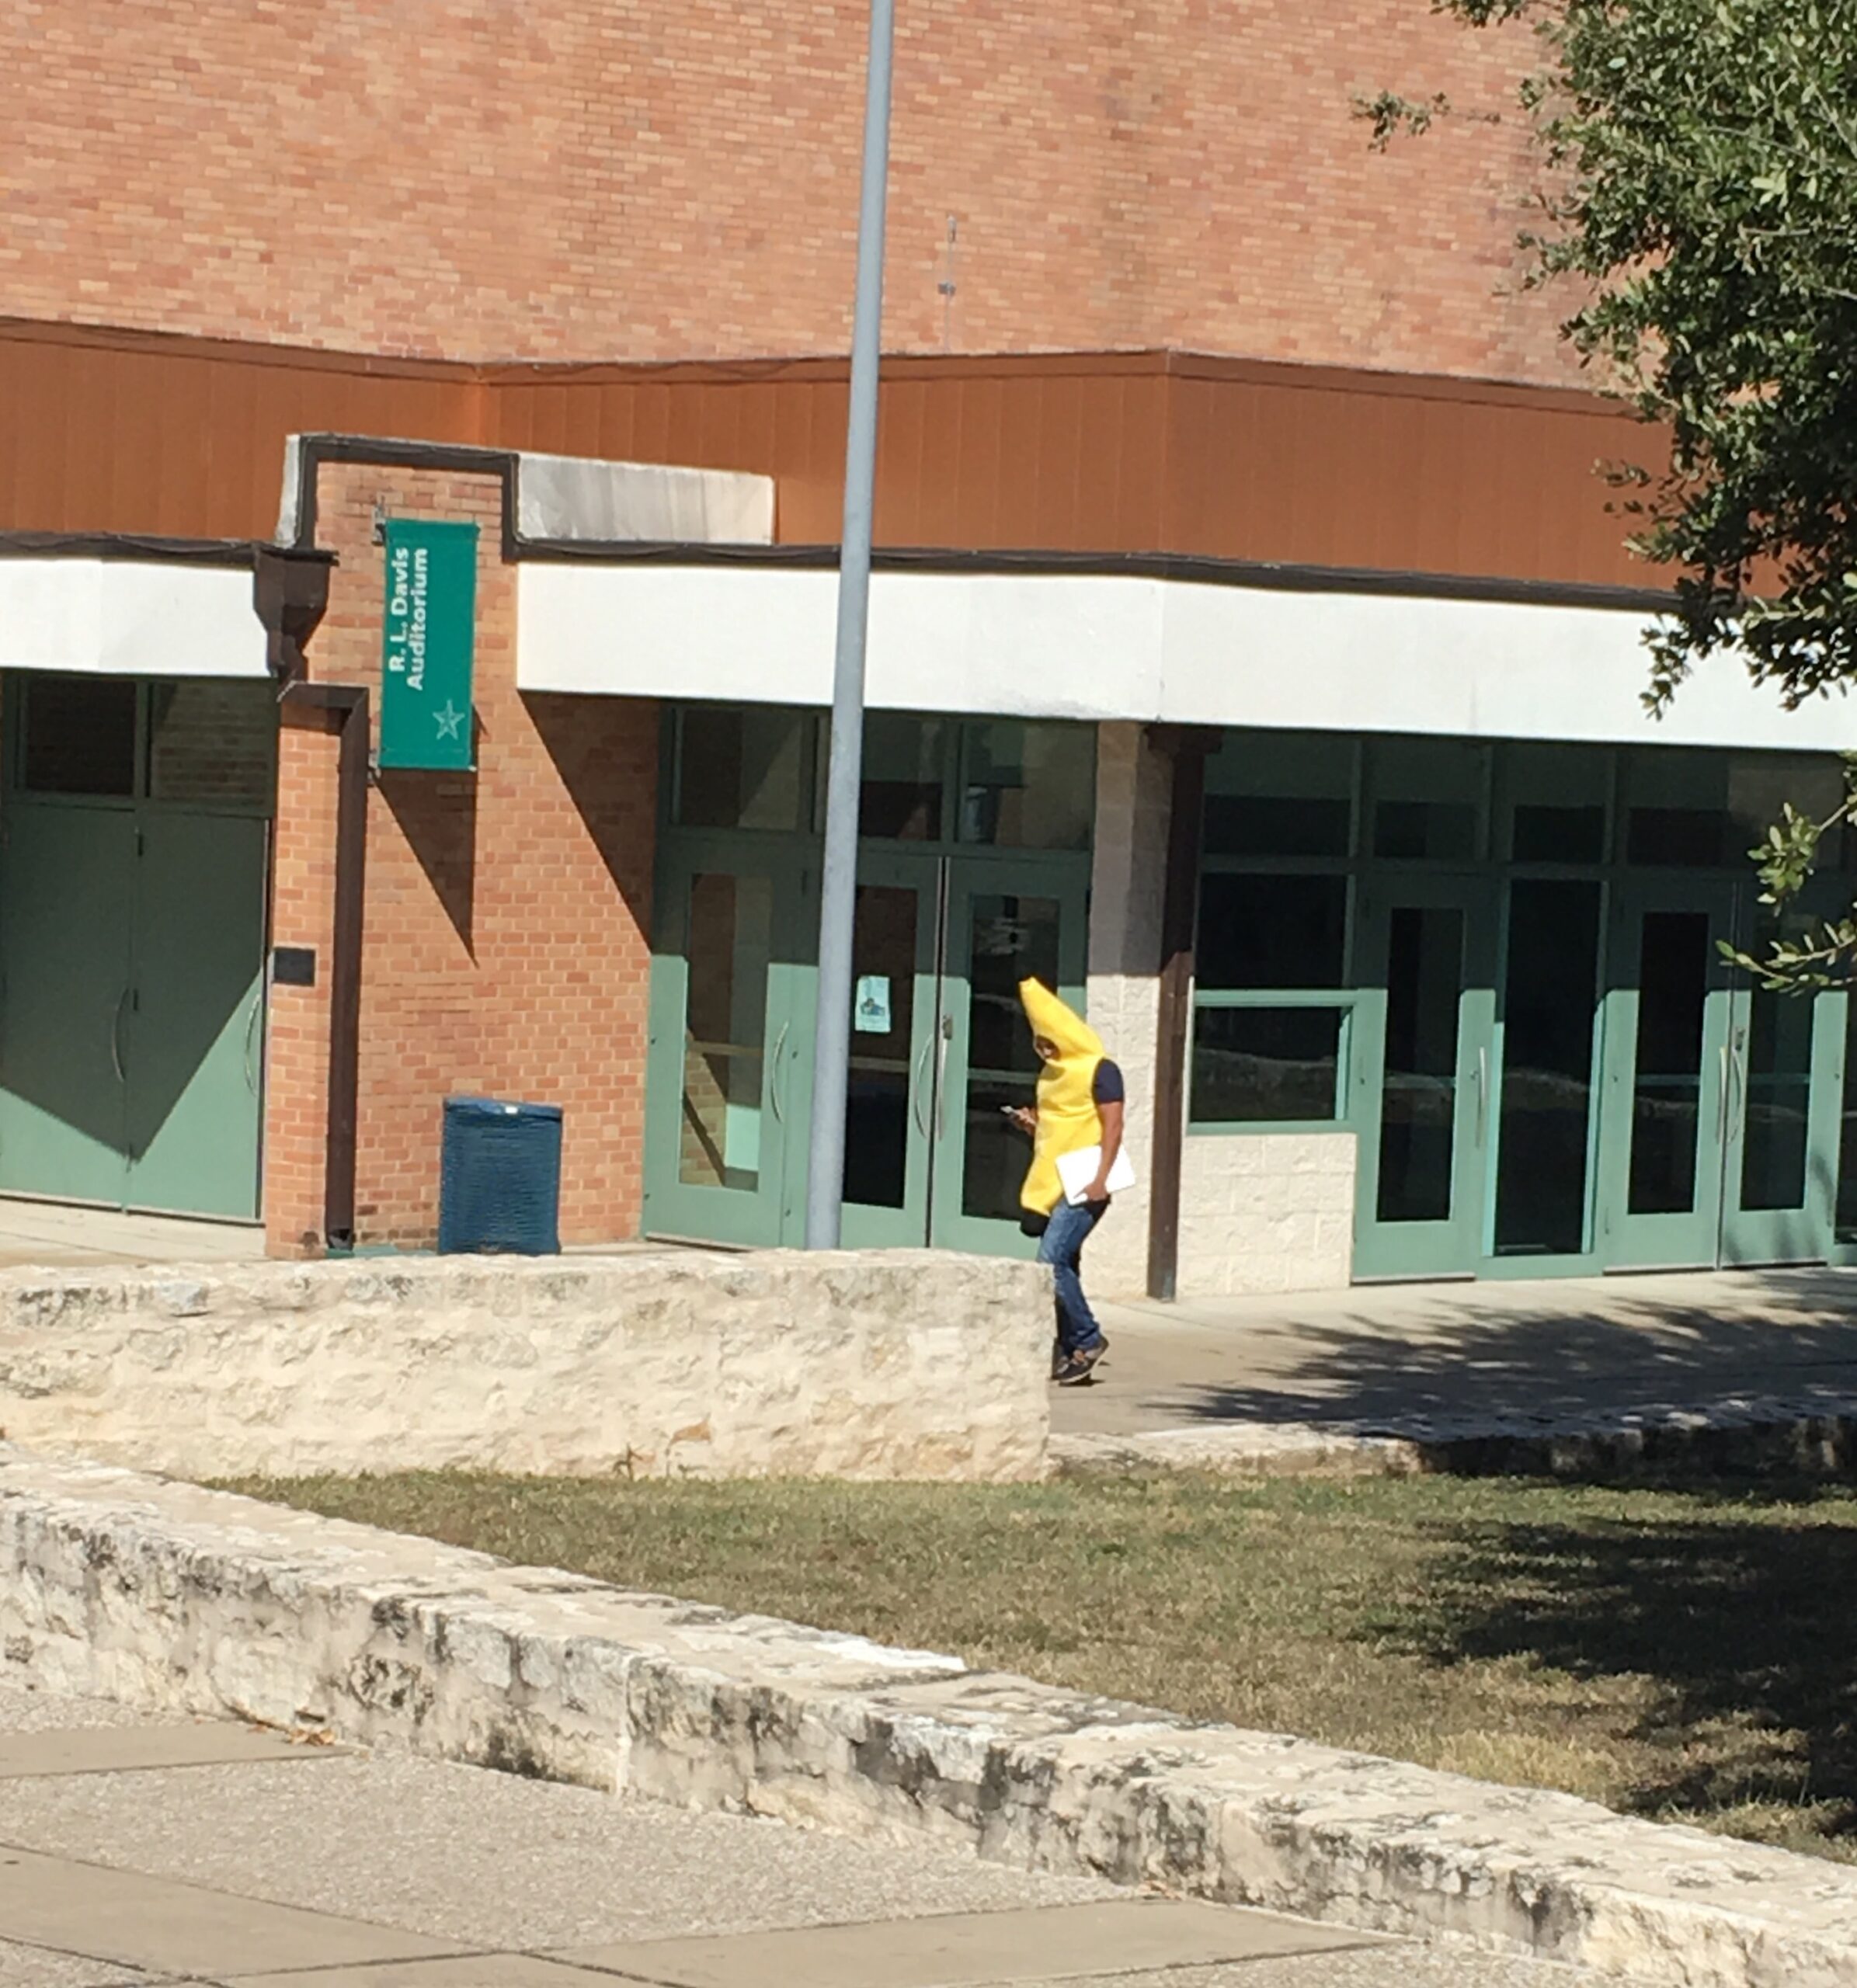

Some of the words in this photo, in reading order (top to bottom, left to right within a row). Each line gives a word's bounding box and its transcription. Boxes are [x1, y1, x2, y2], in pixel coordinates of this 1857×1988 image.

[391, 547, 409, 616] Davis
[390, 622, 408, 642] L.
[406, 548, 428, 690] Auditorium
[388, 648, 406, 672] R.
